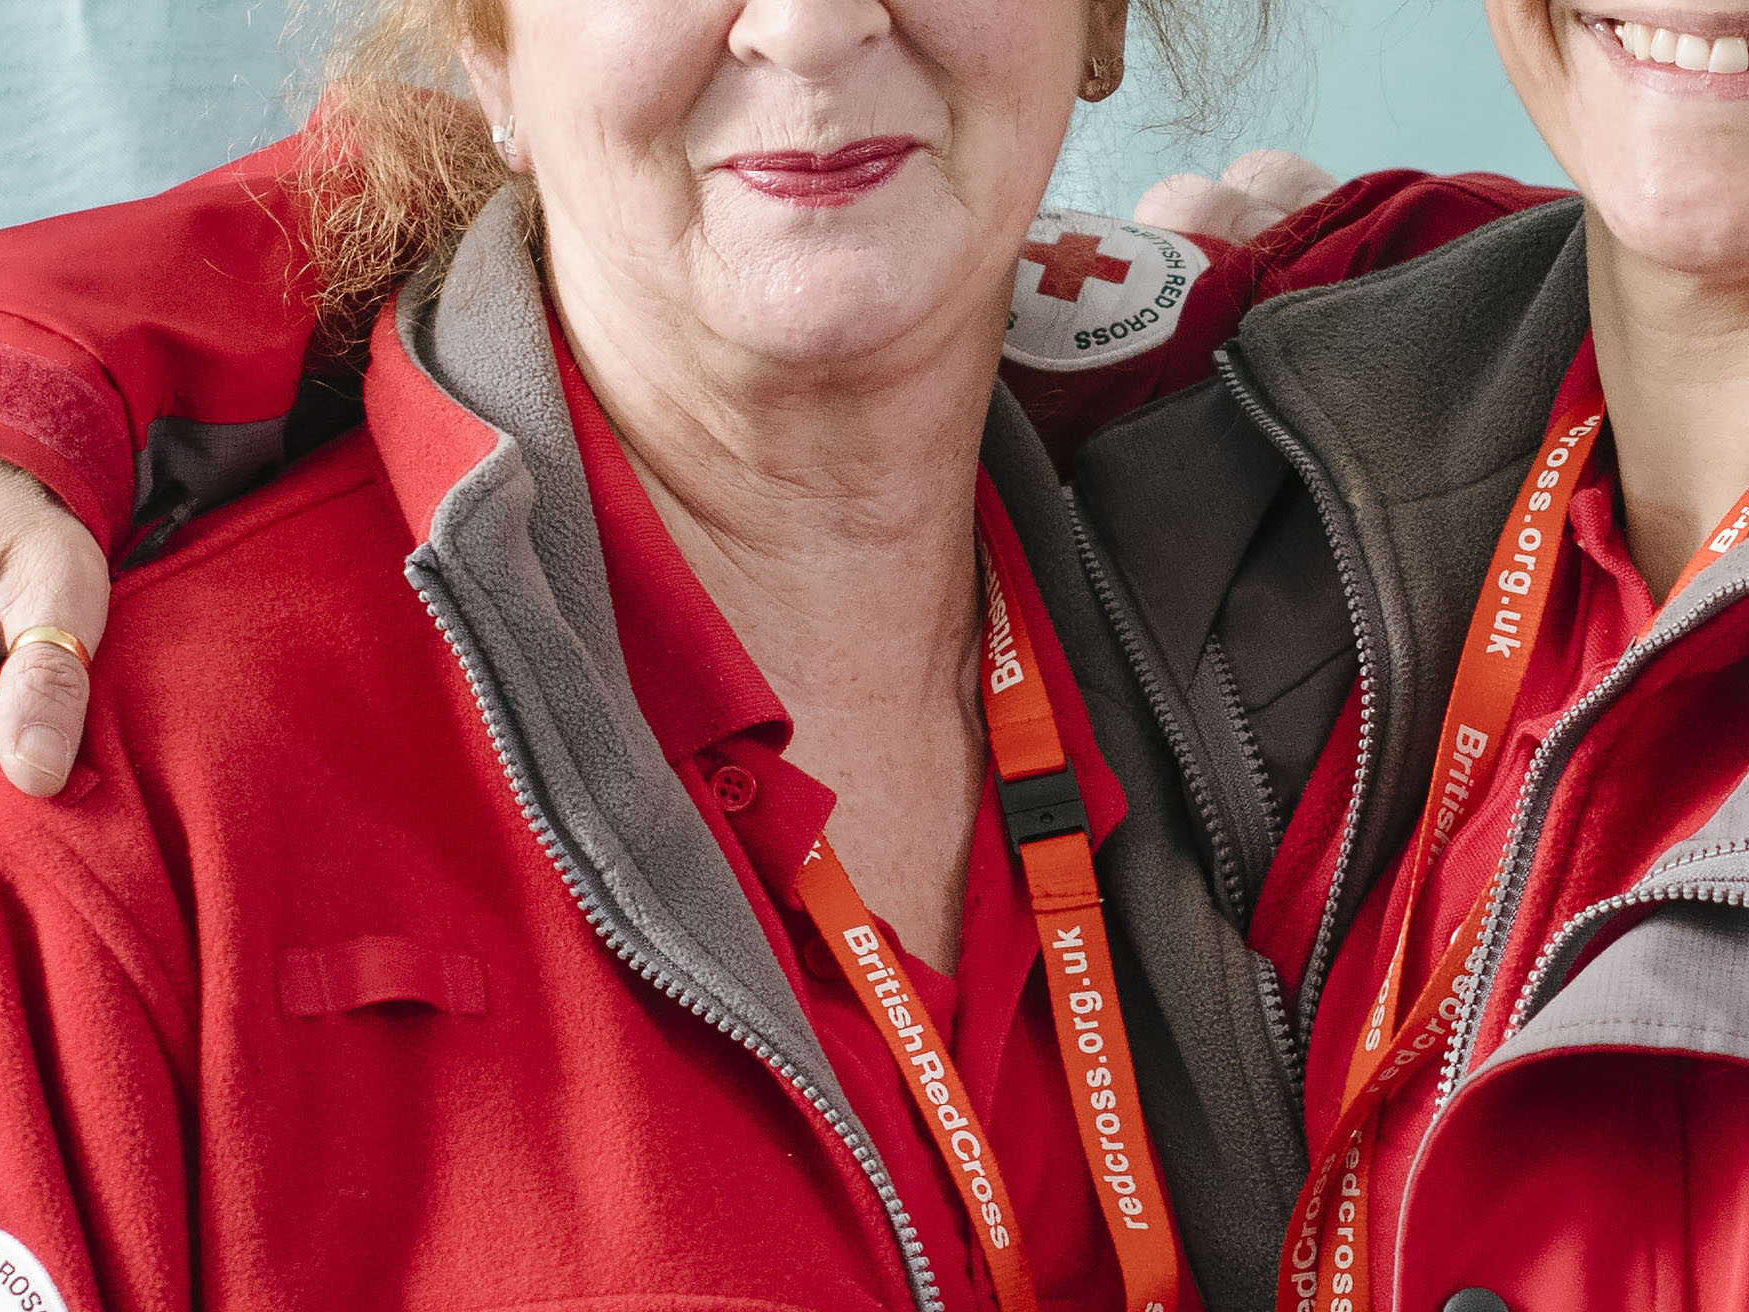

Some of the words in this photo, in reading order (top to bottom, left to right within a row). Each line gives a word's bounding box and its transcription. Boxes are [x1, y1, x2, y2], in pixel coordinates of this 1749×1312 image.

[1121, 226, 1186, 269] BRITISH
[1154, 274, 1186, 309] RED
[1074, 307, 1160, 350] CROSS
[842, 924, 1009, 1250] BritishRedCross
[1051, 925, 1149, 1232] redcross.org.uk
